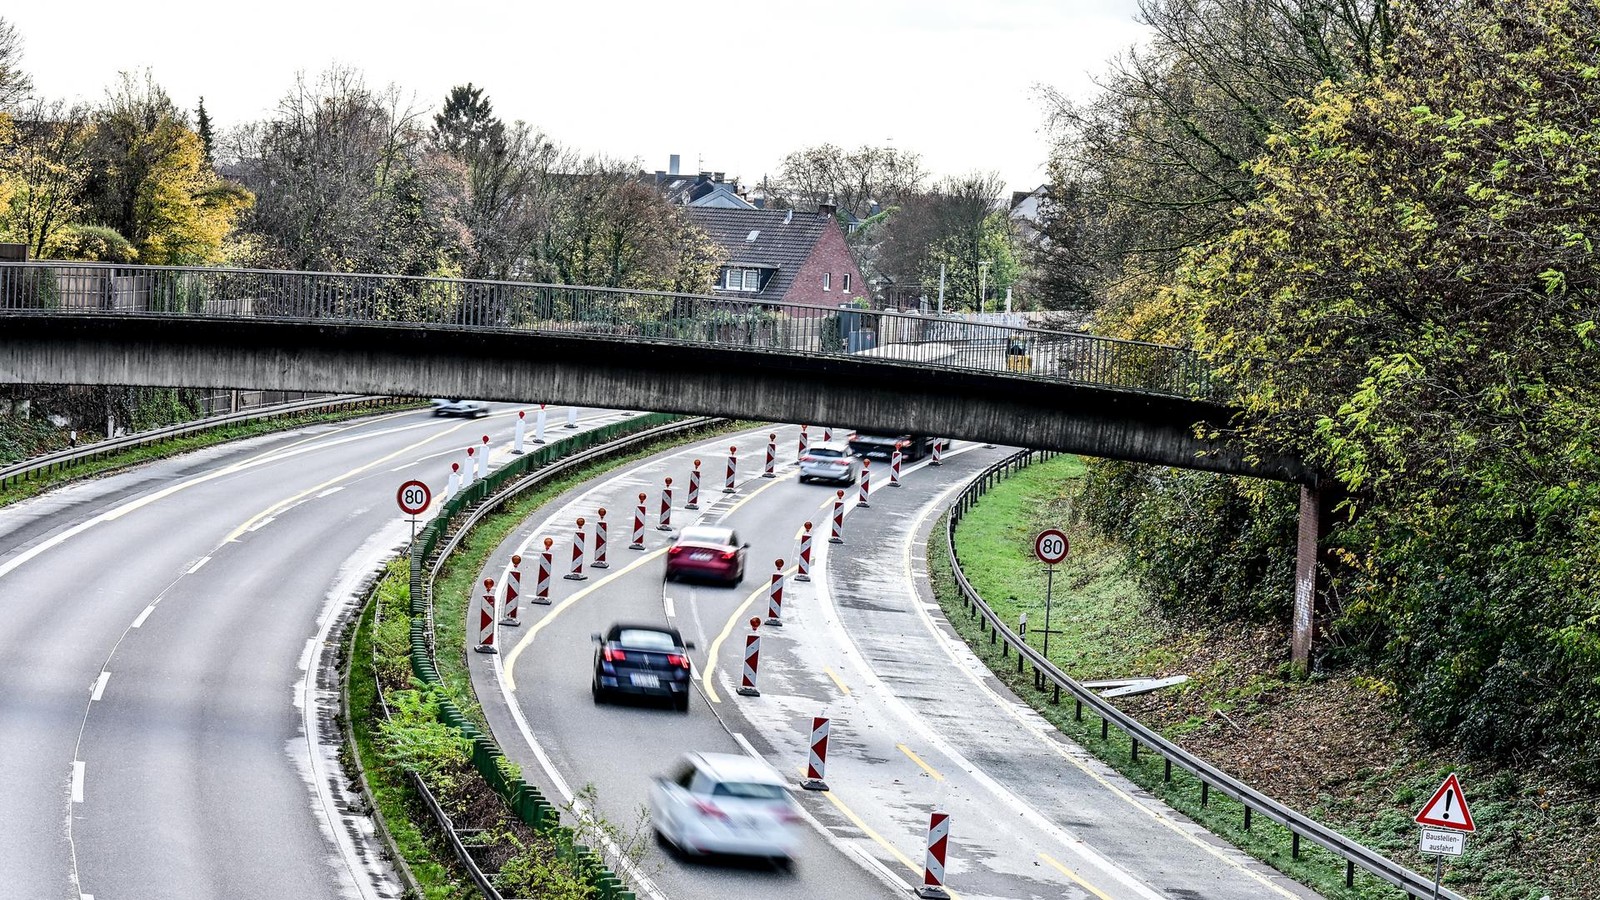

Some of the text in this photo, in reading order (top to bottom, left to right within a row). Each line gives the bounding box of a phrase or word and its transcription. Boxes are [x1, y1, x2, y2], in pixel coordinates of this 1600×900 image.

[405, 489, 423, 504] 80
[1043, 538, 1063, 555] 80
[1425, 832, 1460, 843] Baustellen-
[1429, 844, 1454, 853] ausfahrt
